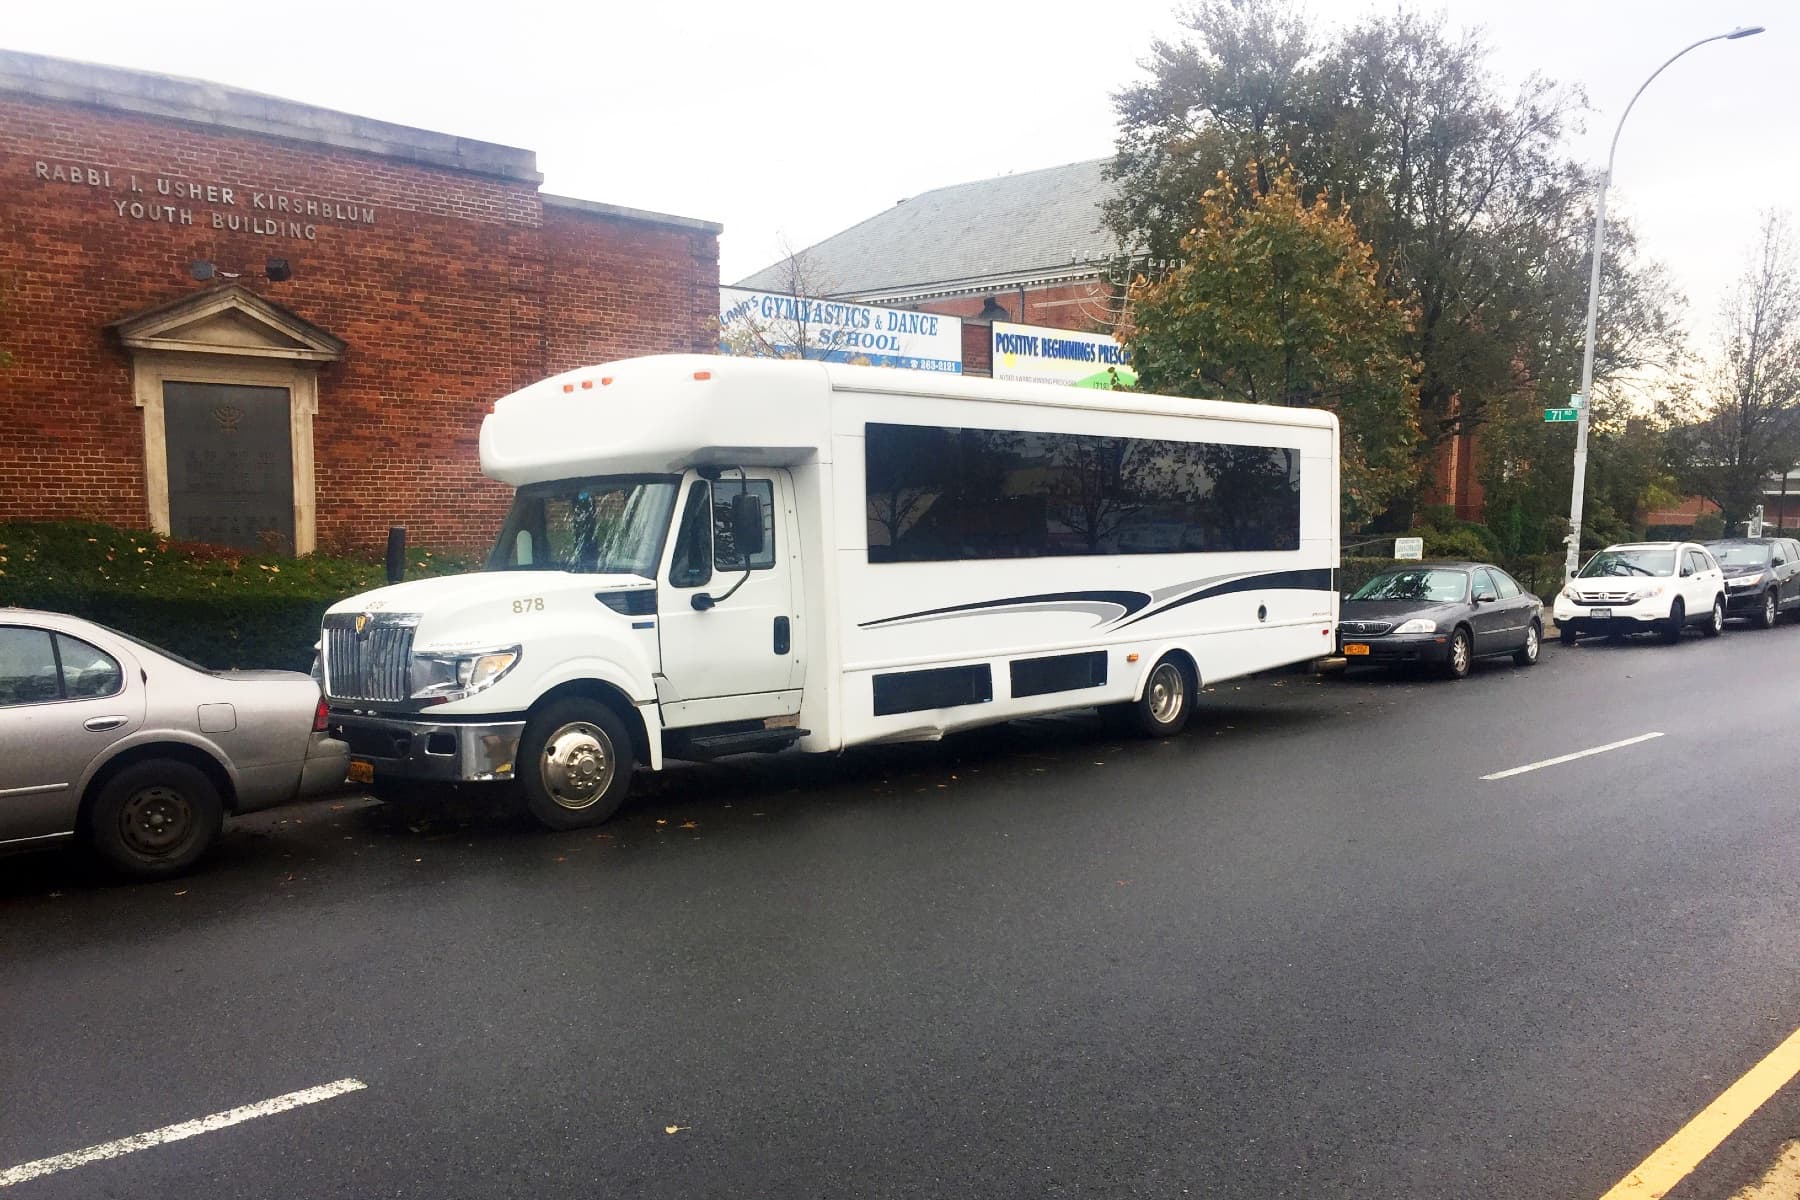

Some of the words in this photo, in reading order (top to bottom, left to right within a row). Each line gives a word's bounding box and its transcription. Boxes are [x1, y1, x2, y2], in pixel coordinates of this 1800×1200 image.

[35, 161, 111, 188] RABBI
[131, 175, 143, 193] I.
[157, 178, 235, 205] USHER
[253, 192, 375, 225] KIRSHBLUM
[113, 200, 193, 225] YOUTH
[212, 212, 317, 240] BUILDING
[761, 296, 871, 330] GYMNASTICS
[875, 315, 882, 330] &
[887, 311, 939, 337] DANCE
[819, 328, 900, 352] SCHOOL
[995, 332, 1040, 357] POSITIVE
[1041, 337, 1096, 363] BEGINNINGS
[1551, 410, 1562, 421] 71
[512, 597, 545, 614] 878
